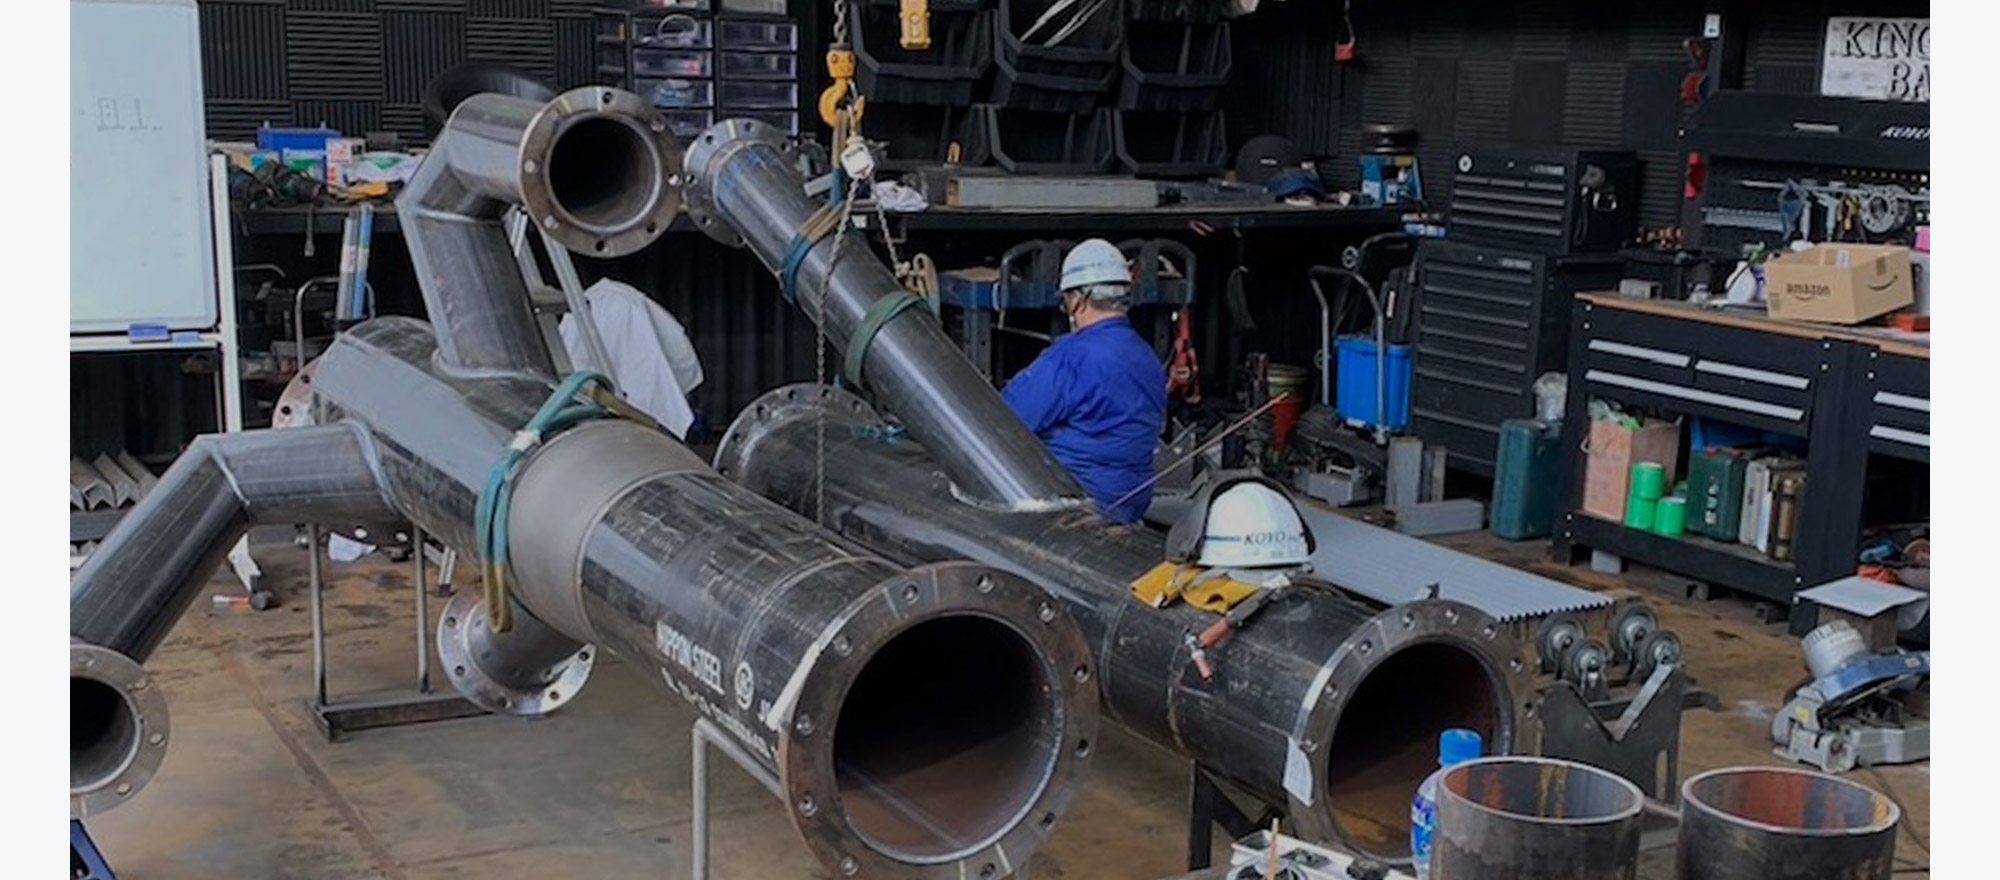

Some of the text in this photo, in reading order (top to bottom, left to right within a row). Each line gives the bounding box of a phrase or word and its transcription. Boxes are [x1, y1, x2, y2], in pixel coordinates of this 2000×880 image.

[1786, 283, 1831, 296] amazon
[1244, 530, 1286, 546] KOYO
[691, 643, 726, 696] STEEL
